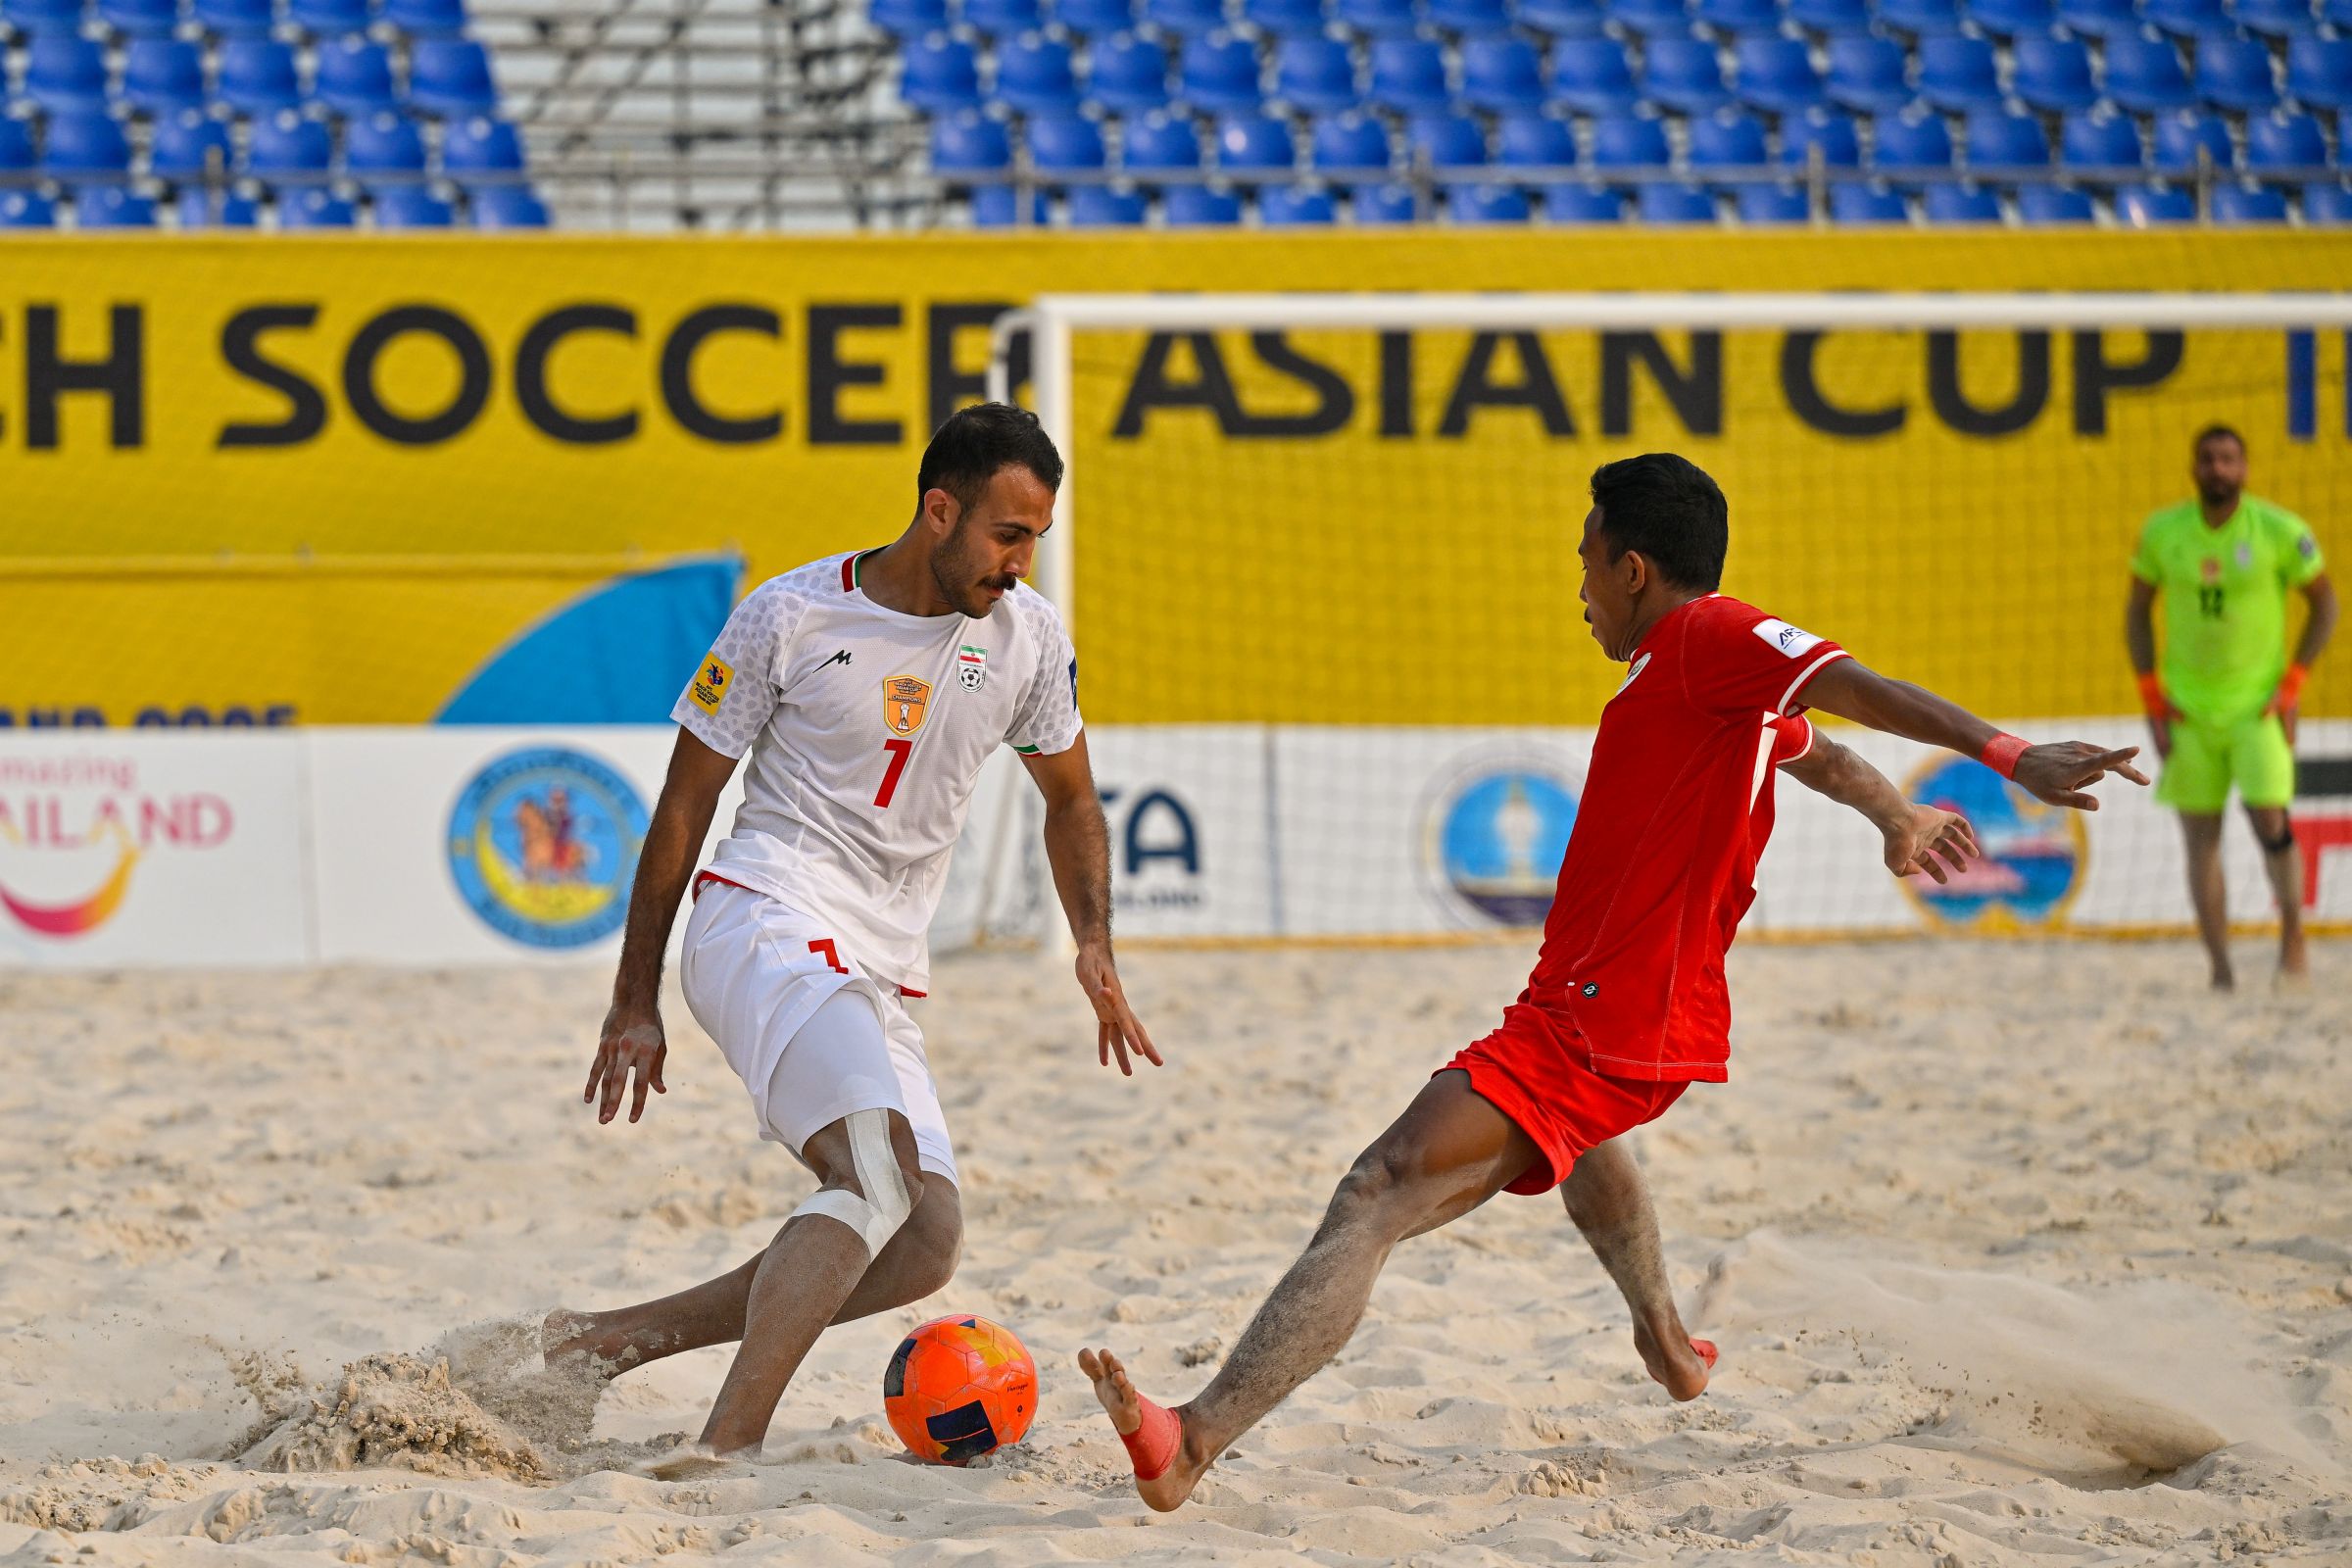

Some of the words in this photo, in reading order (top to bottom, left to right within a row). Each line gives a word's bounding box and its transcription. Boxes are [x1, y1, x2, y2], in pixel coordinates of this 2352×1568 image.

[0, 302, 145, 449] H
[1111, 323, 1725, 437] ASIAN
[1778, 323, 2187, 437] CUP
[873, 738, 912, 808] 7
